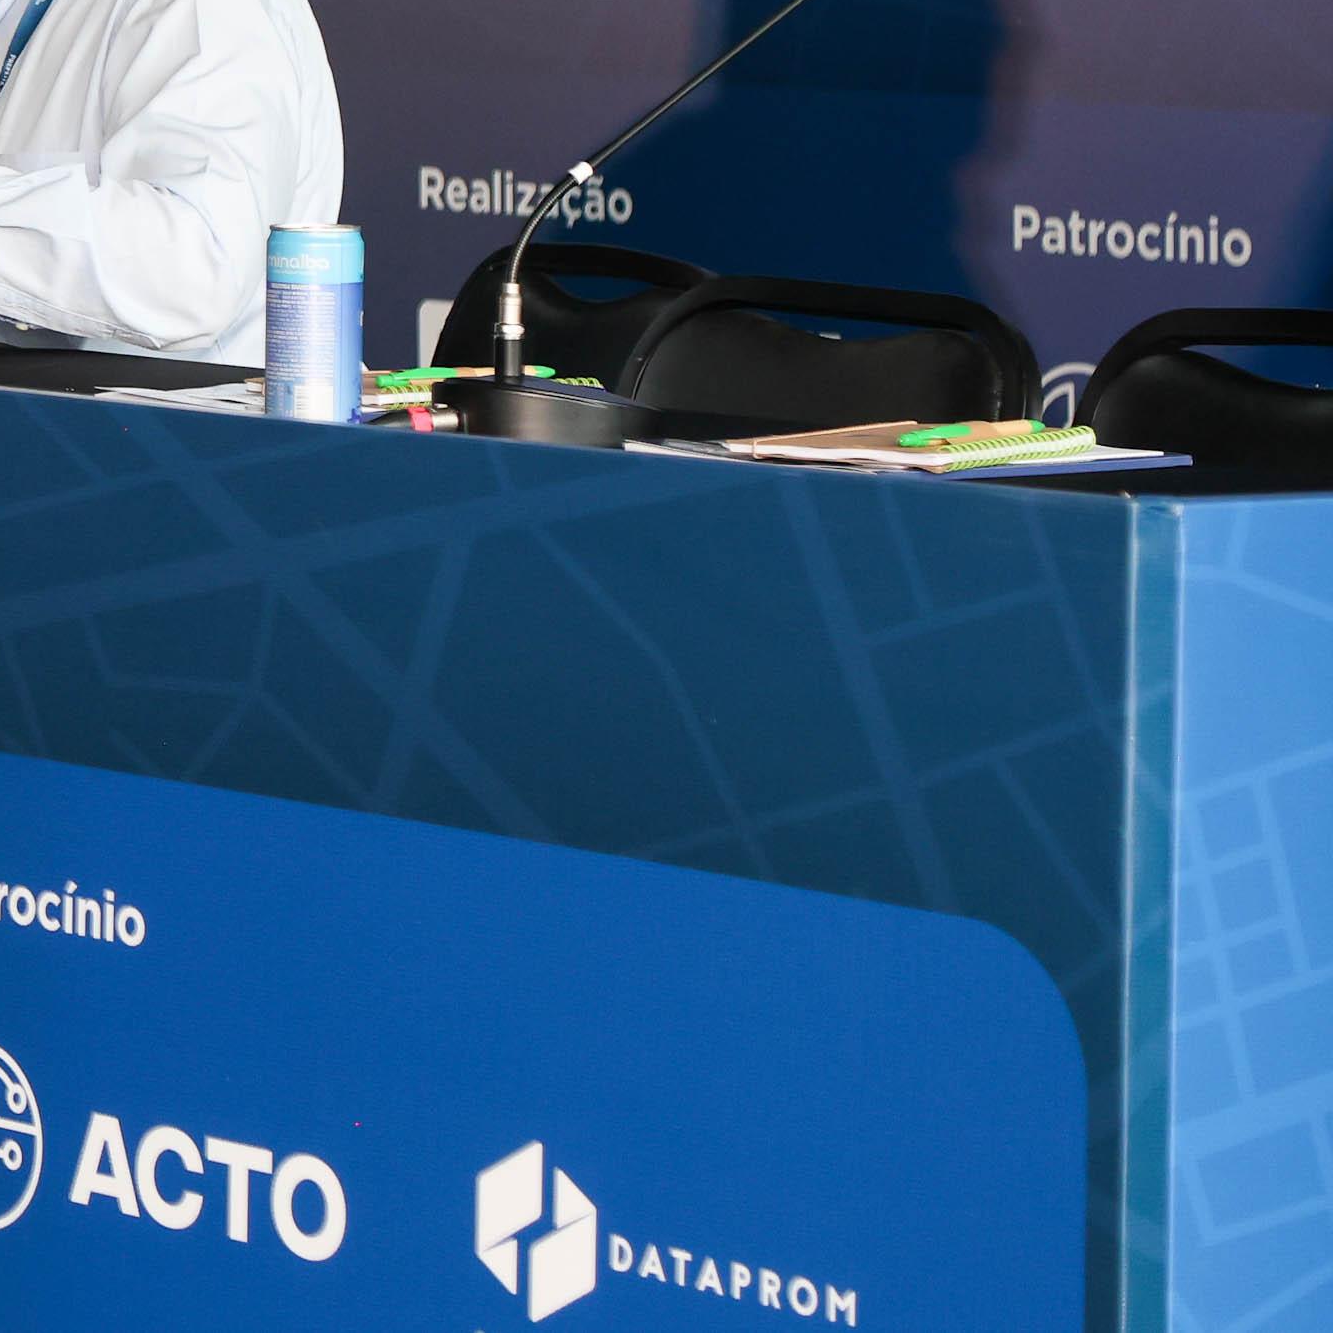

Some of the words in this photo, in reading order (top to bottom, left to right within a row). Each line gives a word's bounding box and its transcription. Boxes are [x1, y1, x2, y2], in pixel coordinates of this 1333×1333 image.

[1012, 202, 1253, 268] Patrocínio
[69, 1113, 347, 1263] ACTO
[610, 1234, 859, 1328] DATAPROM
